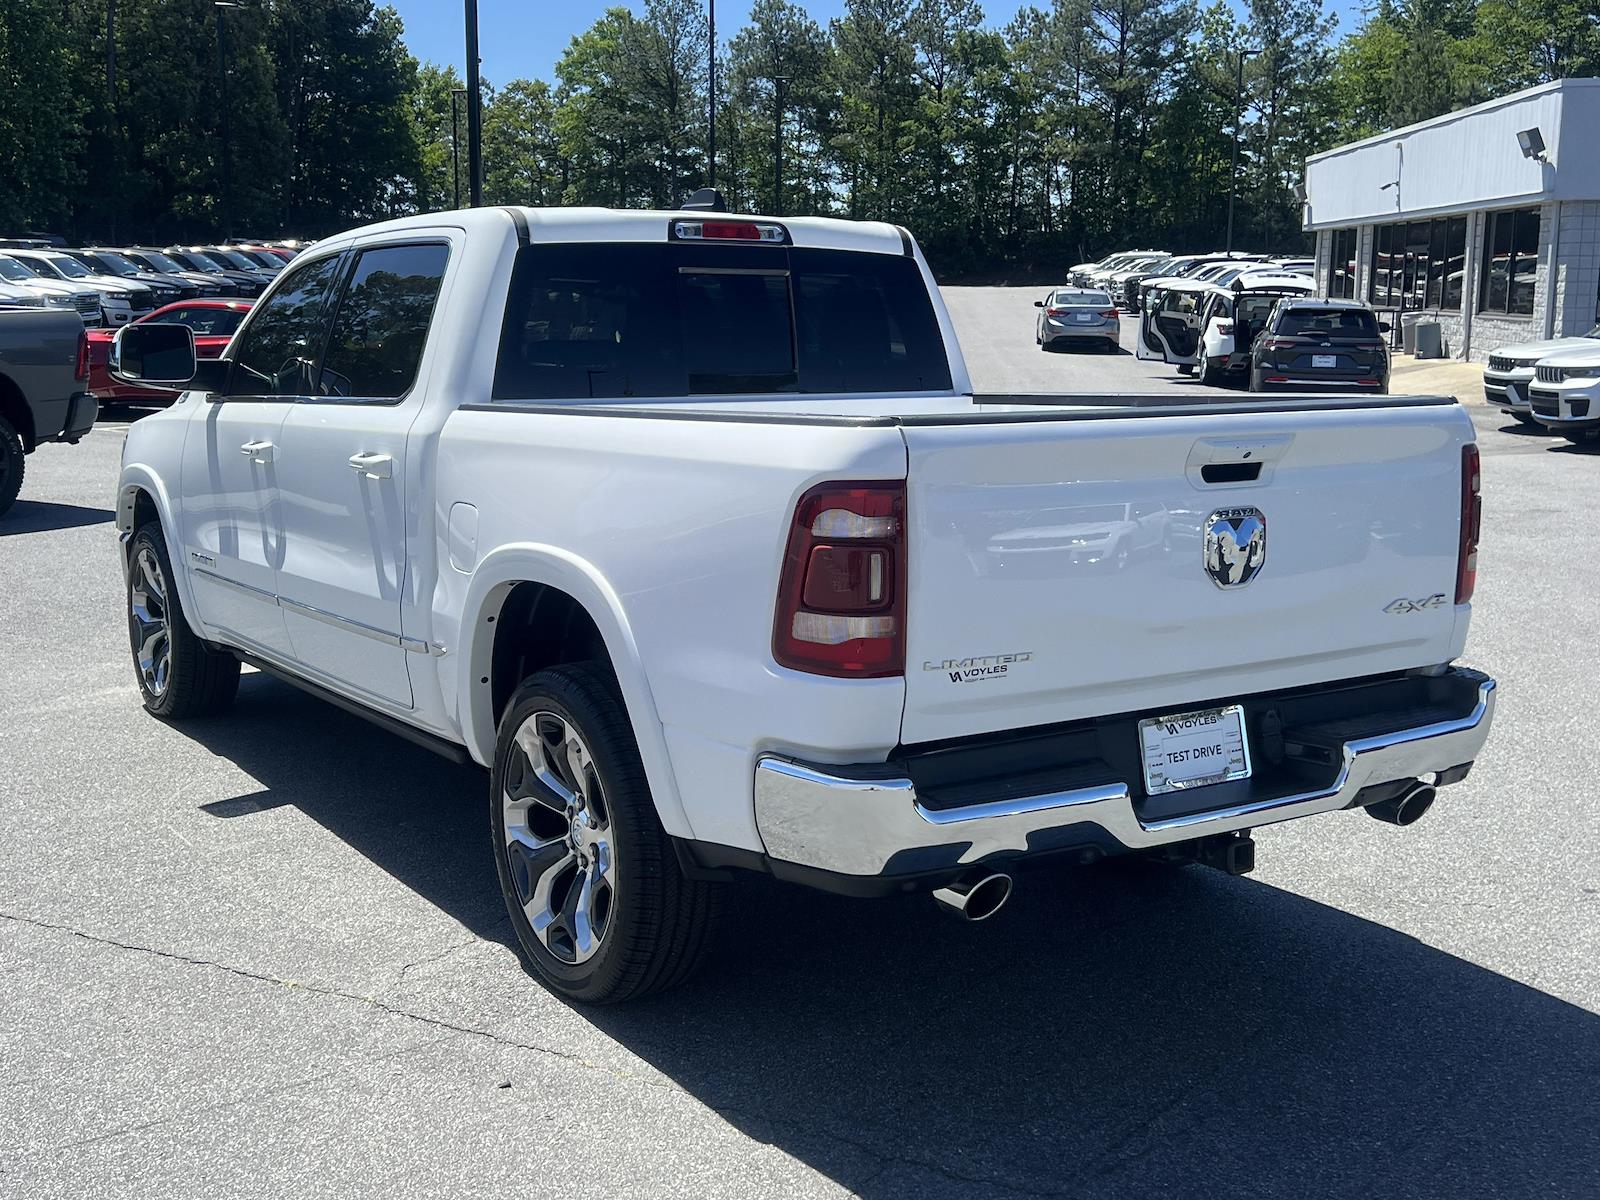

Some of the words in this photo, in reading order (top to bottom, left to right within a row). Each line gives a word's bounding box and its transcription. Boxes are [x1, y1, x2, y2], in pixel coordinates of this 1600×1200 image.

[923, 651, 1033, 671] LIMITED
[963, 664, 1008, 677] VOYLES
[1178, 715, 1217, 729] VOYLES
[1166, 750, 1190, 764] TEST
[1193, 744, 1222, 759] DRIVE
